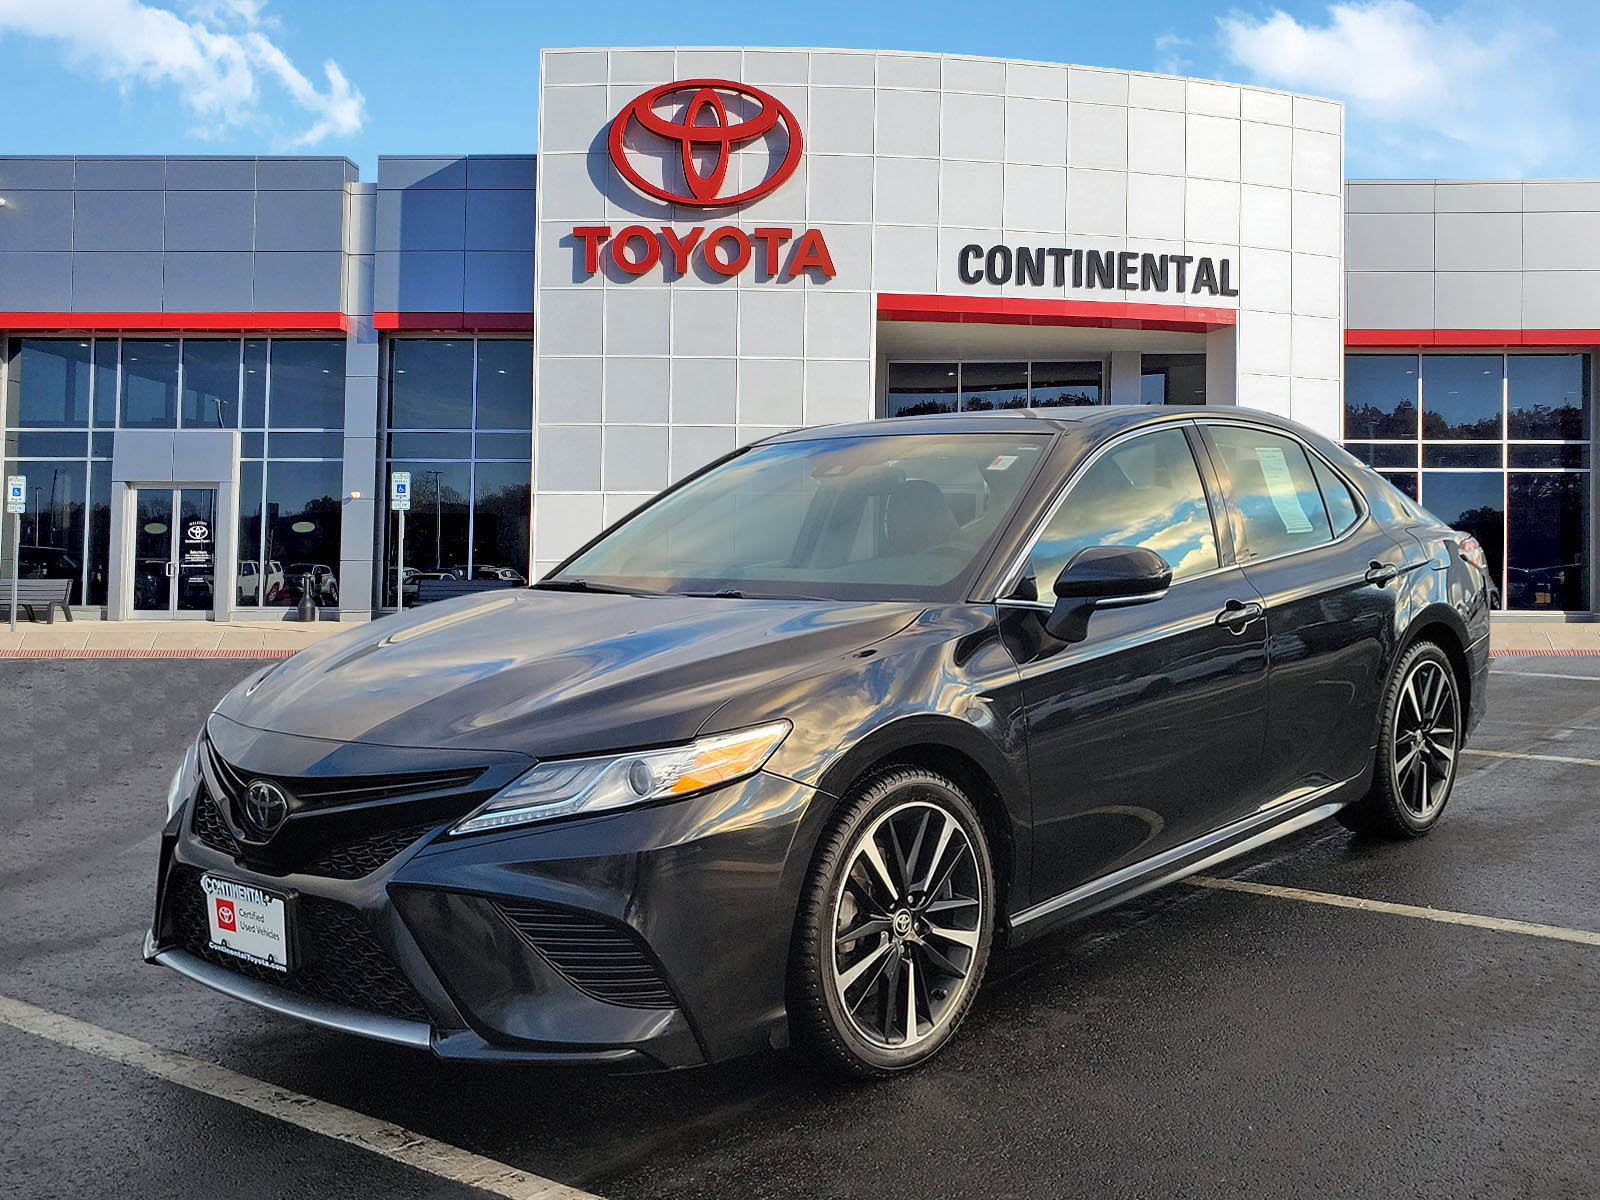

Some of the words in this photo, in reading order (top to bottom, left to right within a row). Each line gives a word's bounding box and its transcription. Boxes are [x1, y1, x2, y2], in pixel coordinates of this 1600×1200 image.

[573, 225, 837, 277] TOYOTA
[958, 244, 1239, 297] CONTINENTAL
[201, 875, 265, 905] CONTINENTAL
[239, 907, 265, 923] Certified
[240, 921, 256, 933] Used
[256, 925, 280, 941] Vehicles
